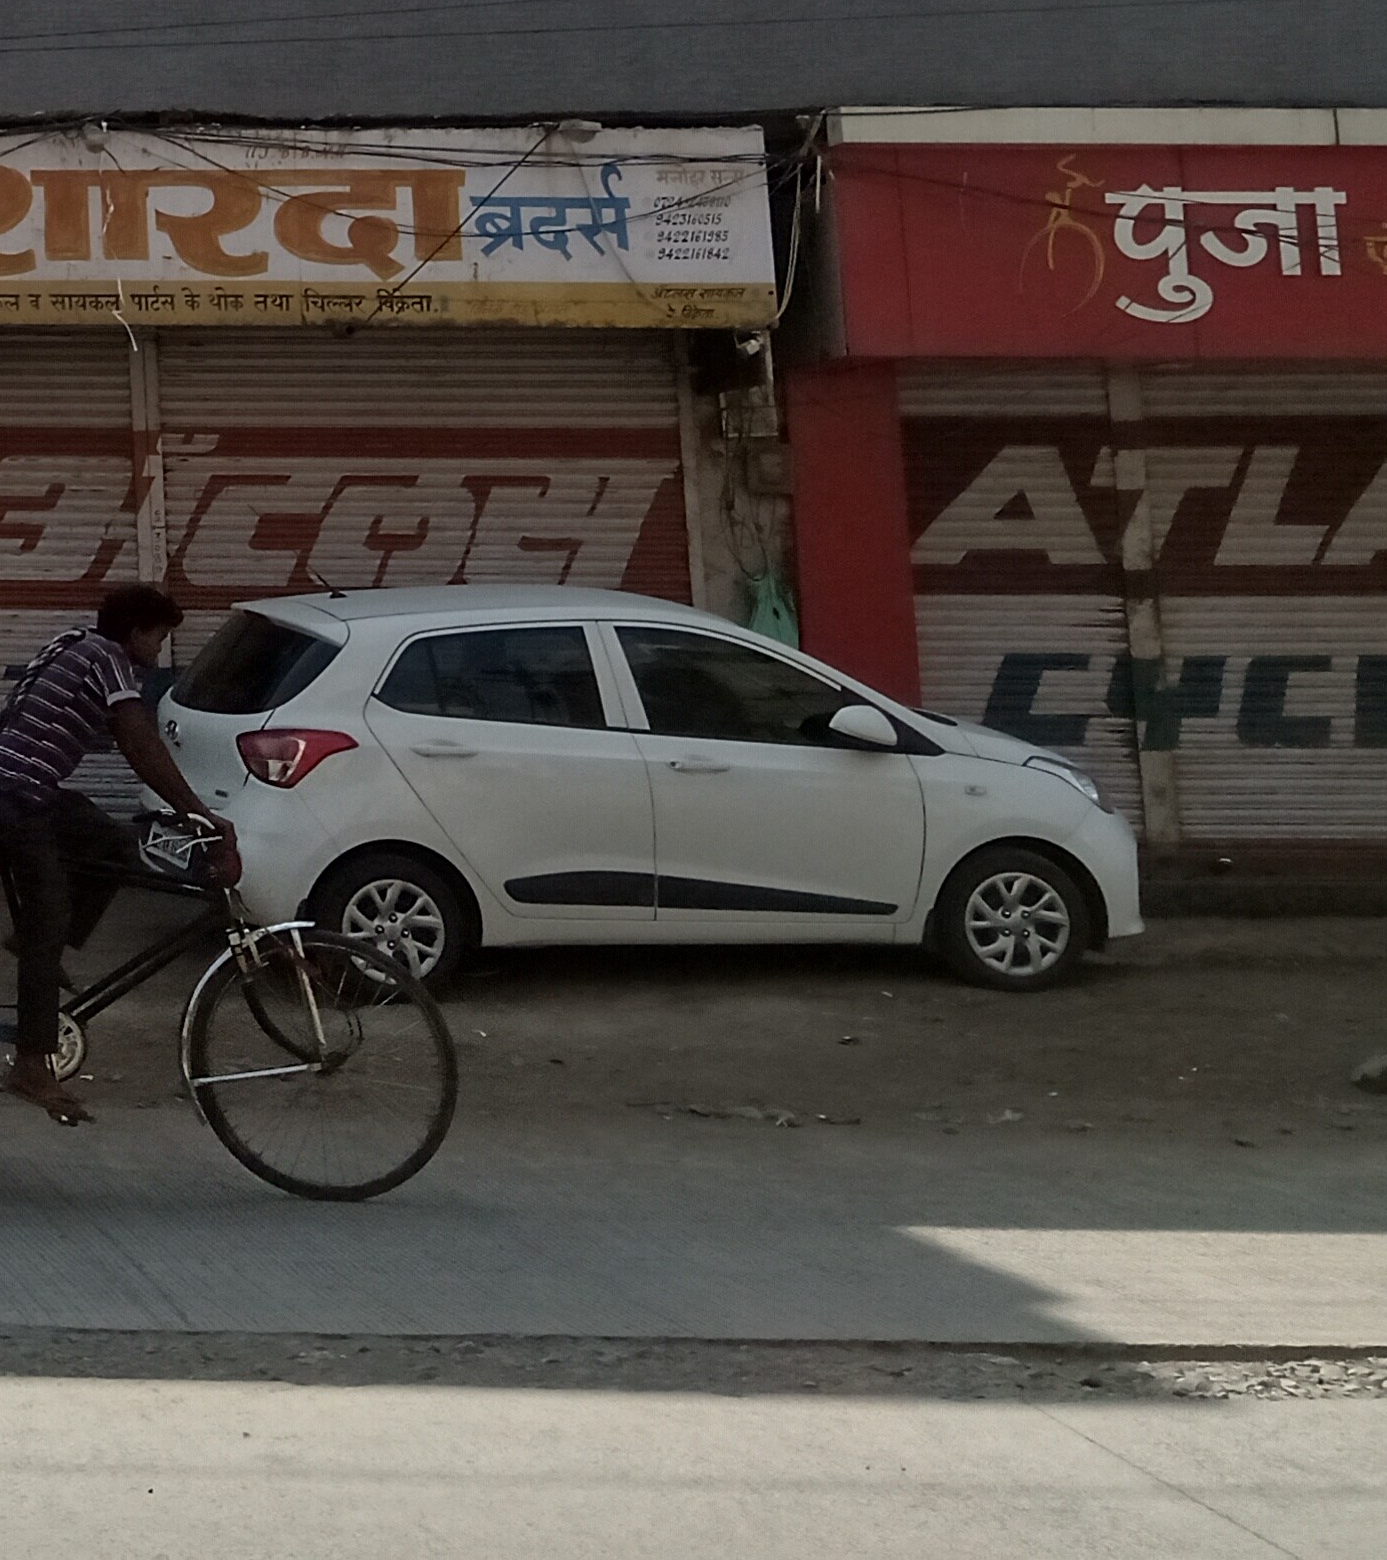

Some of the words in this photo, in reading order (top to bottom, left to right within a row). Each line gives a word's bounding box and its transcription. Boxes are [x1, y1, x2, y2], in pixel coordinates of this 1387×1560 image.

[470, 161, 633, 263] ब्रदर्स
[27, 293, 42, 312] व
[48, 293, 121, 312] सायकल
[181, 287, 202, 312] के
[208, 286, 245, 312] थोक
[253, 293, 294, 312] तथा
